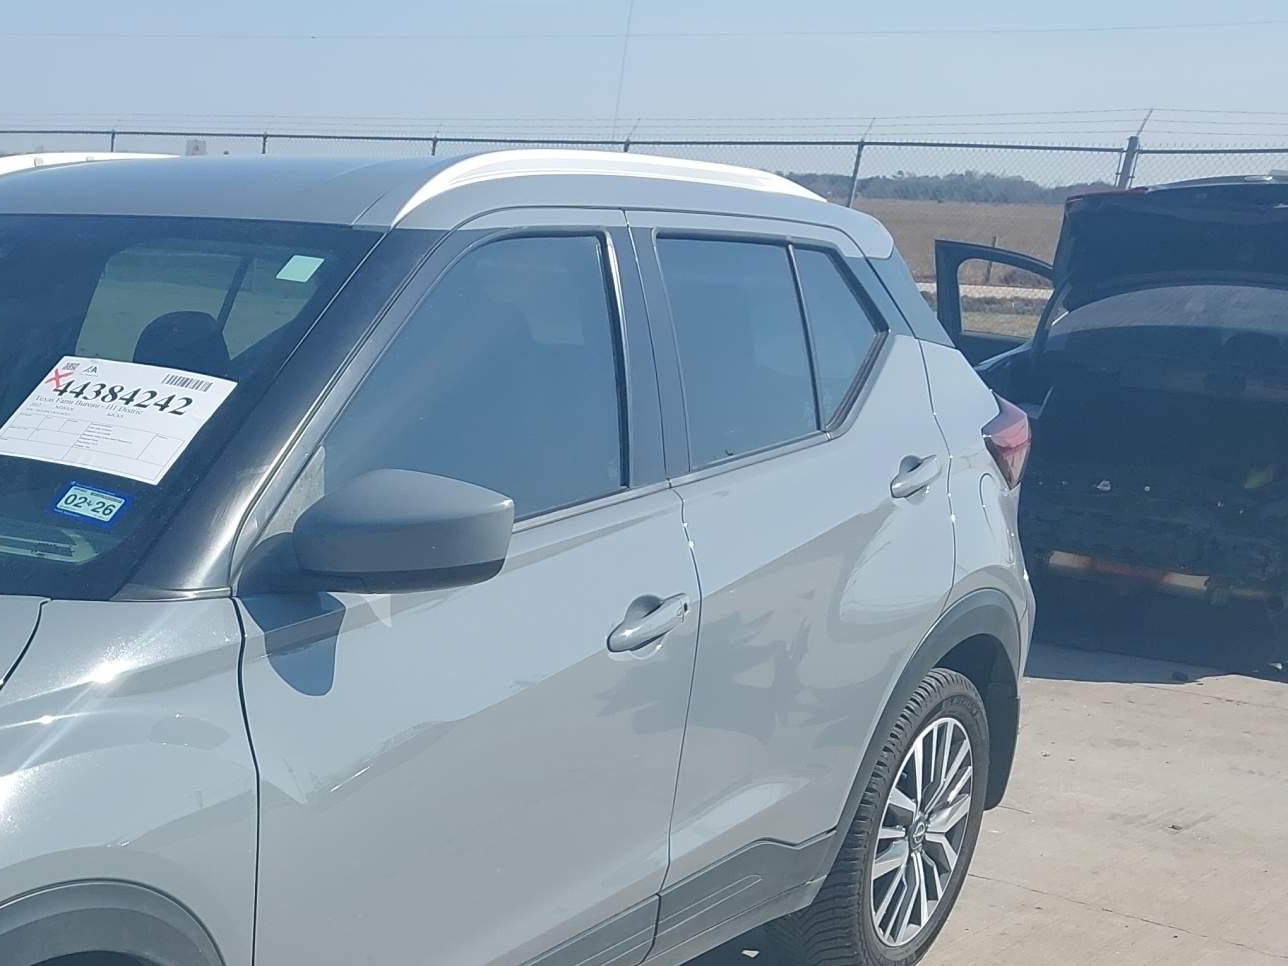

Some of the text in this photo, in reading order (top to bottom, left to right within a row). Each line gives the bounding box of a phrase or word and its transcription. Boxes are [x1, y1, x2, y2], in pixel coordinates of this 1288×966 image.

[53, 380, 193, 416] 44384242
[64, 494, 88, 508] 02
[91, 501, 116, 516] 26
